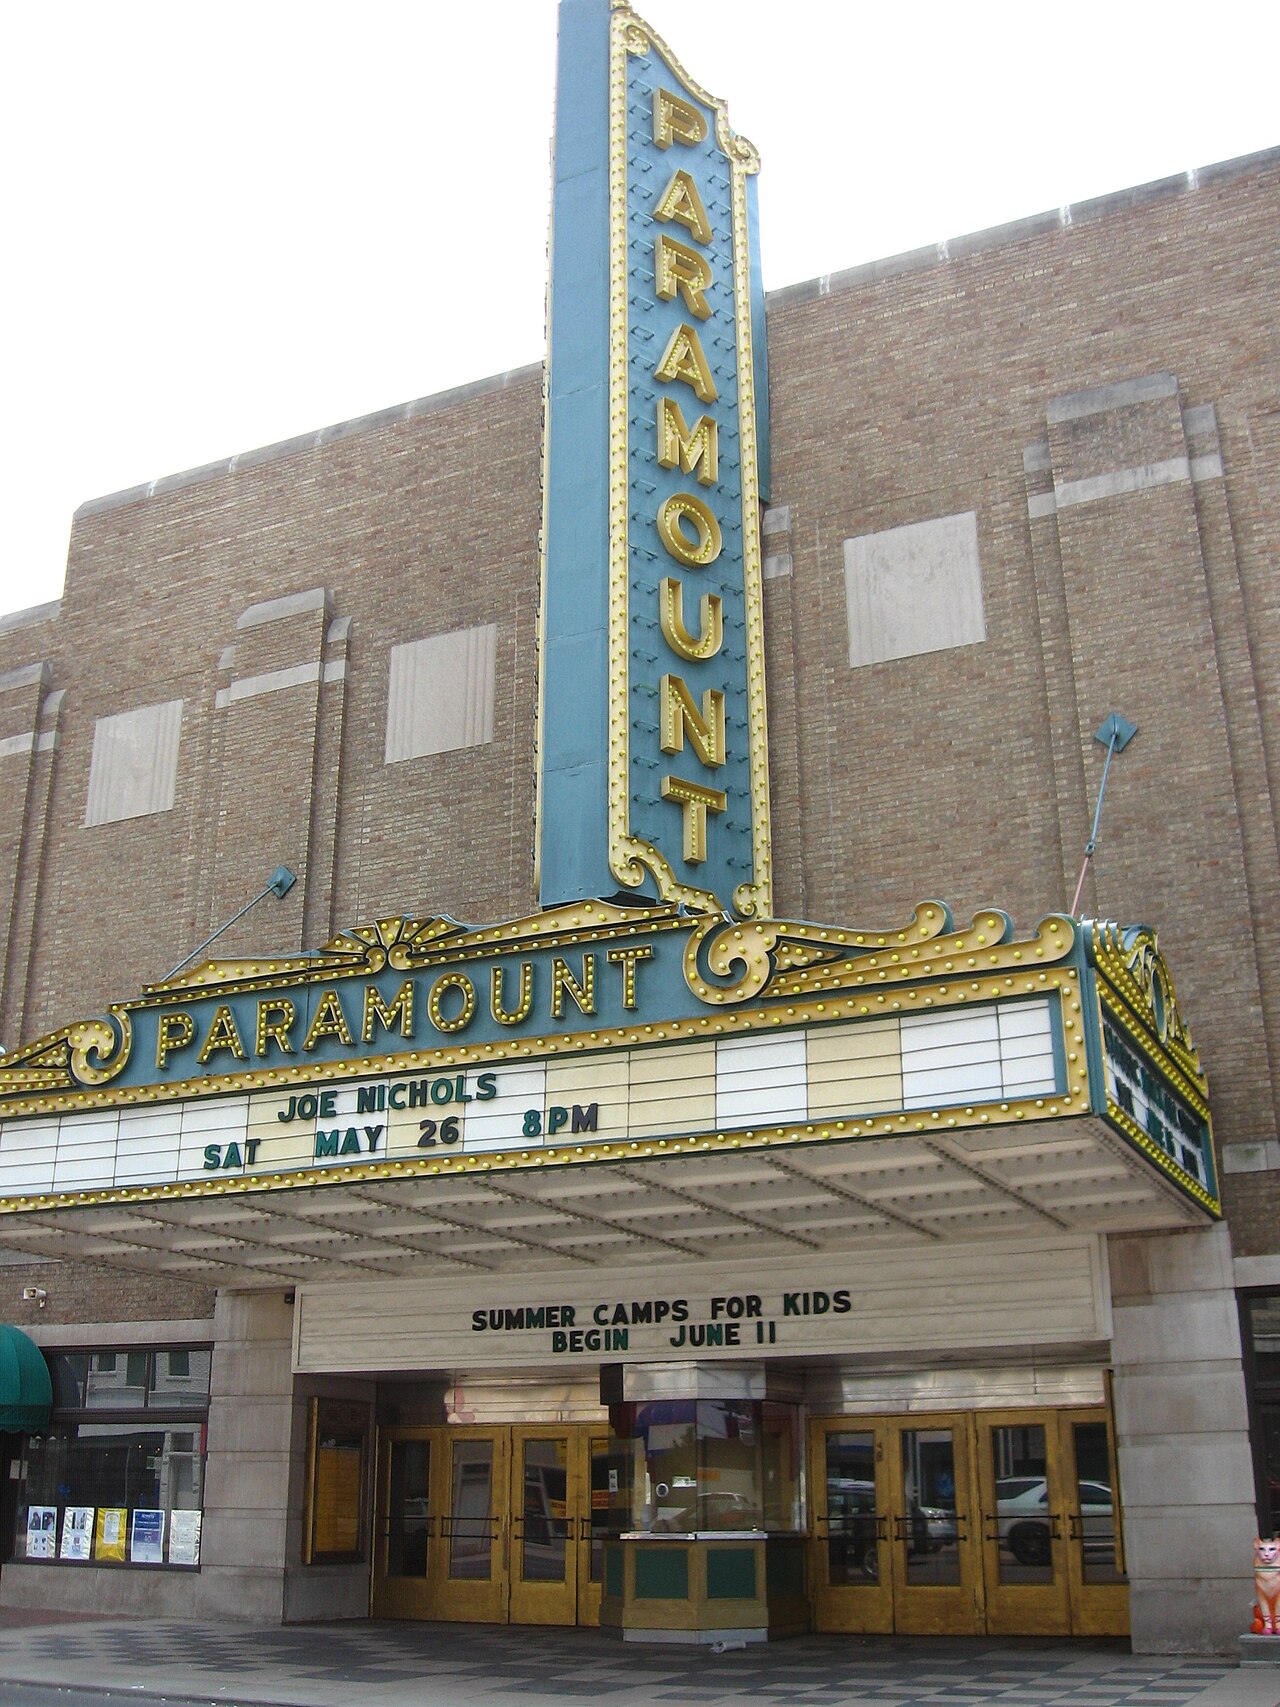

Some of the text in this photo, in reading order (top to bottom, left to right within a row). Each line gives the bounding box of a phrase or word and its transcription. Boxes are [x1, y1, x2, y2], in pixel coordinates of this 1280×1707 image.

[653, 87, 727, 864] PARAMOUNT
[156, 945, 653, 1068] PARAMOUNT
[278, 1073, 497, 1123] JOE NICHOLS
[203, 1138, 261, 1170] SAT
[315, 1125, 384, 1157] MAY
[418, 1116, 460, 1146] 26
[472, 1290, 852, 1331] SUMMER CAMPS FOR KIDS
[552, 1328, 630, 1353] BEGIN
[670, 1323, 741, 1348] JUNE
